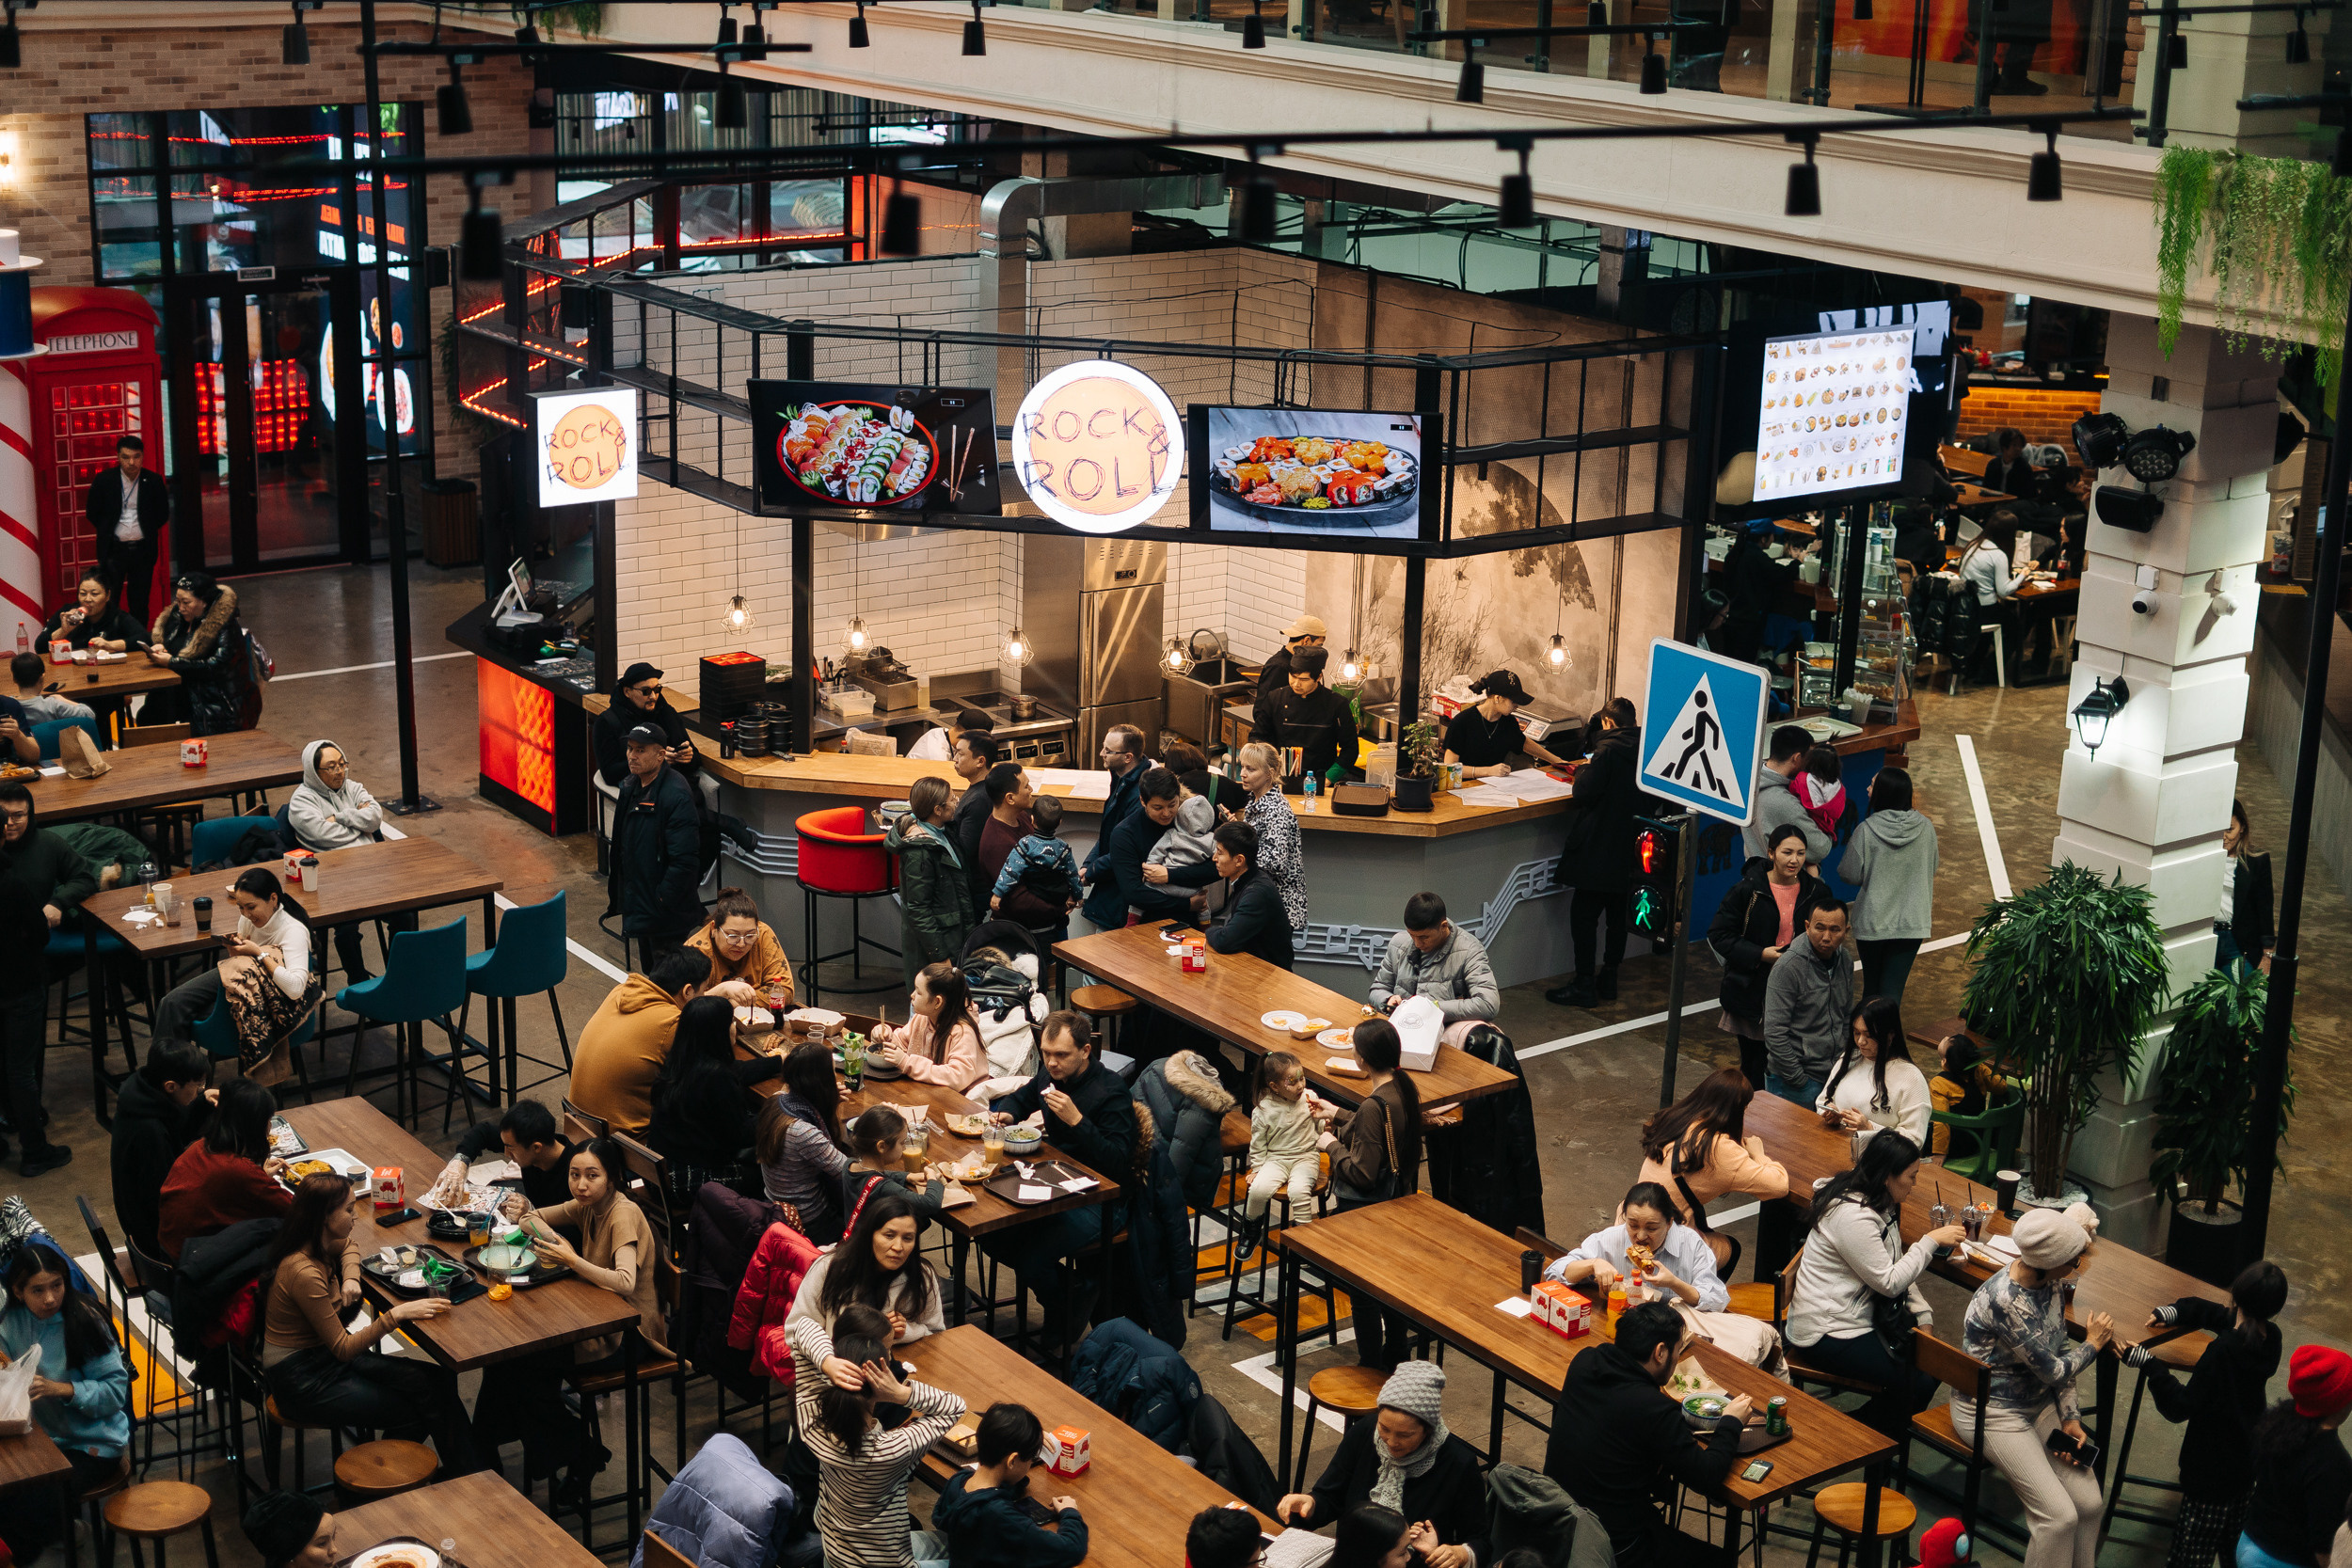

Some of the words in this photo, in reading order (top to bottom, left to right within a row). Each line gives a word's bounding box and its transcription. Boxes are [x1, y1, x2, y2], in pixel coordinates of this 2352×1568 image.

[47, 332, 136, 352] TELEPHONE
[545, 419, 616, 450] ROCK
[1023, 406, 1150, 442] ROCK
[1147, 423, 1170, 455] &
[547, 446, 629, 486] ROLL
[1024, 455, 1176, 501] ROLL
[856, 1189, 869, 1211] reima
[849, 1212, 858, 1230] reima
